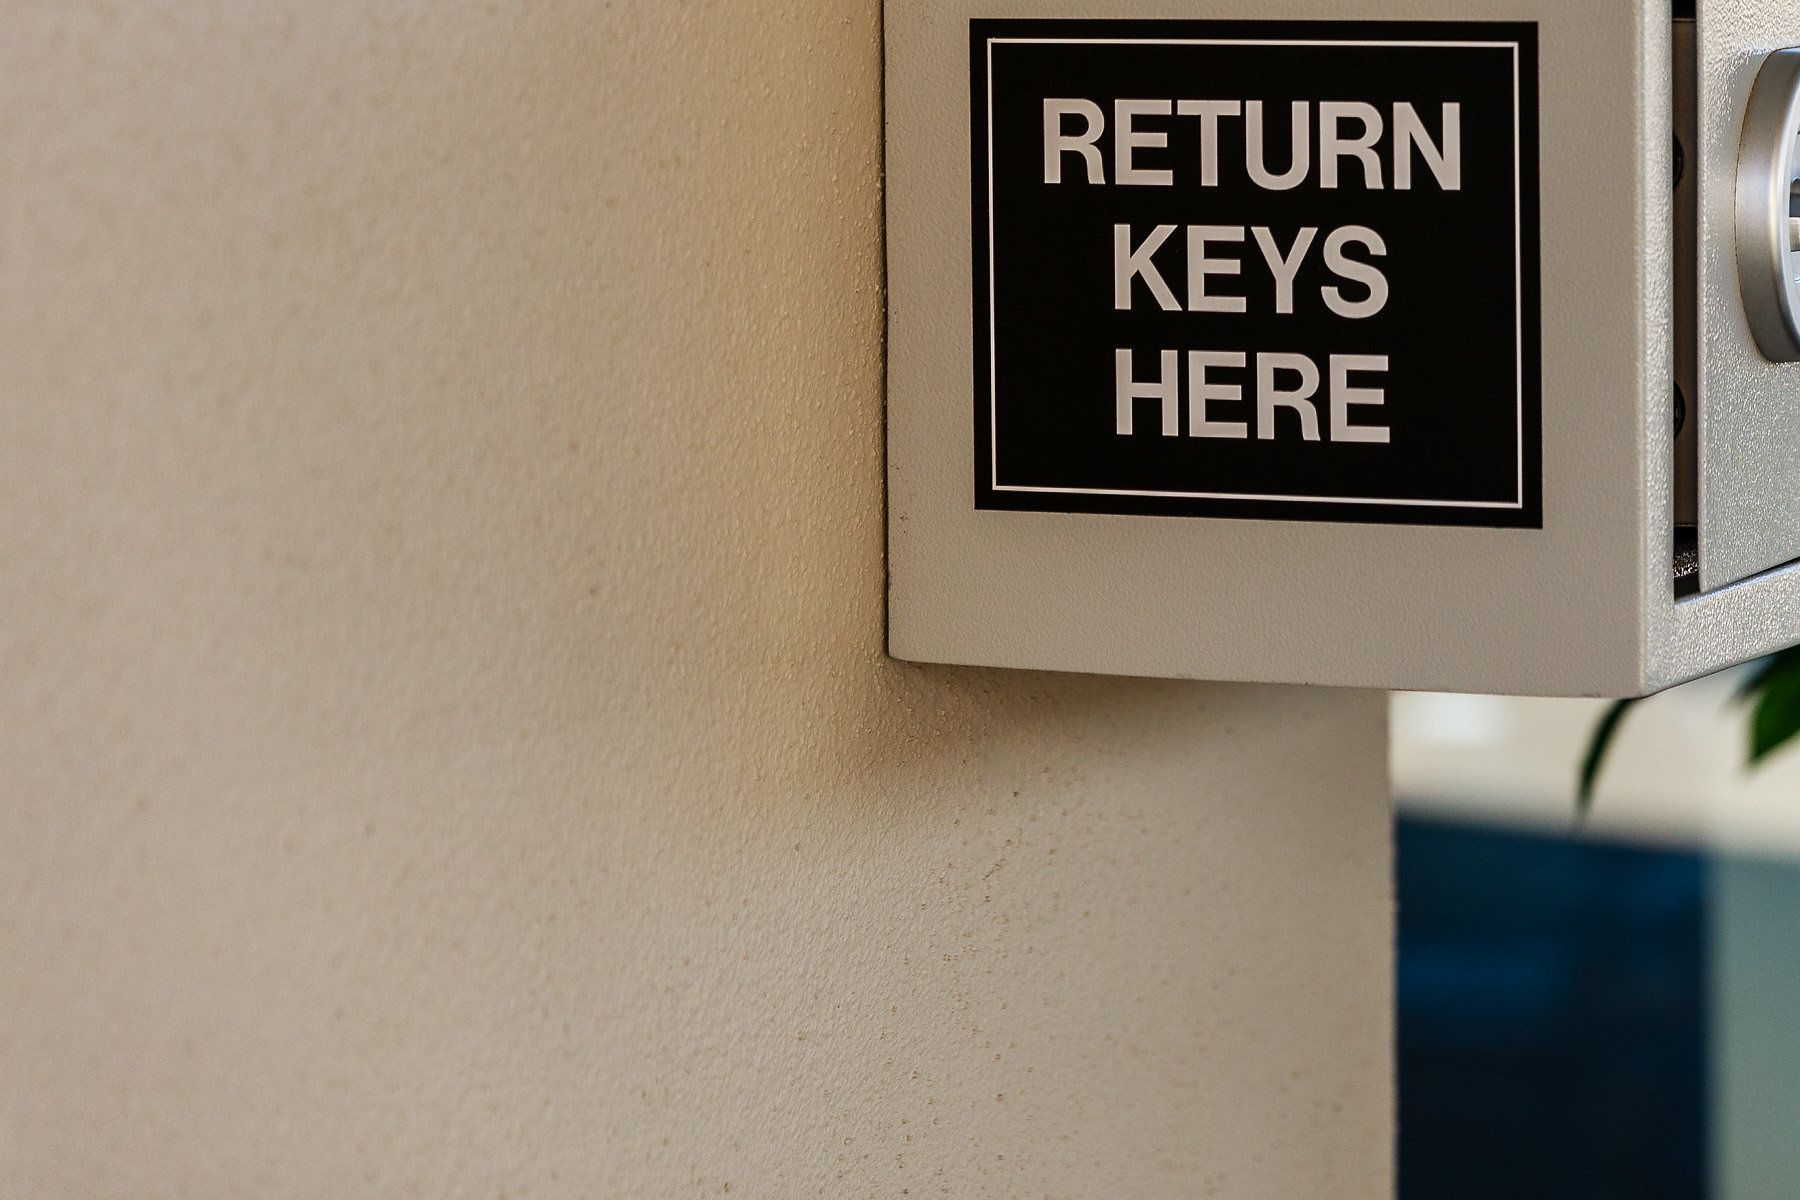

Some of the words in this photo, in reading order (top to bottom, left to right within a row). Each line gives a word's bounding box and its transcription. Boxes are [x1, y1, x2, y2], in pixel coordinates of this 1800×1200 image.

[1043, 98, 1461, 191] RETURN
[1113, 224, 1390, 319] KEYS
[1115, 348, 1391, 444] HERE
